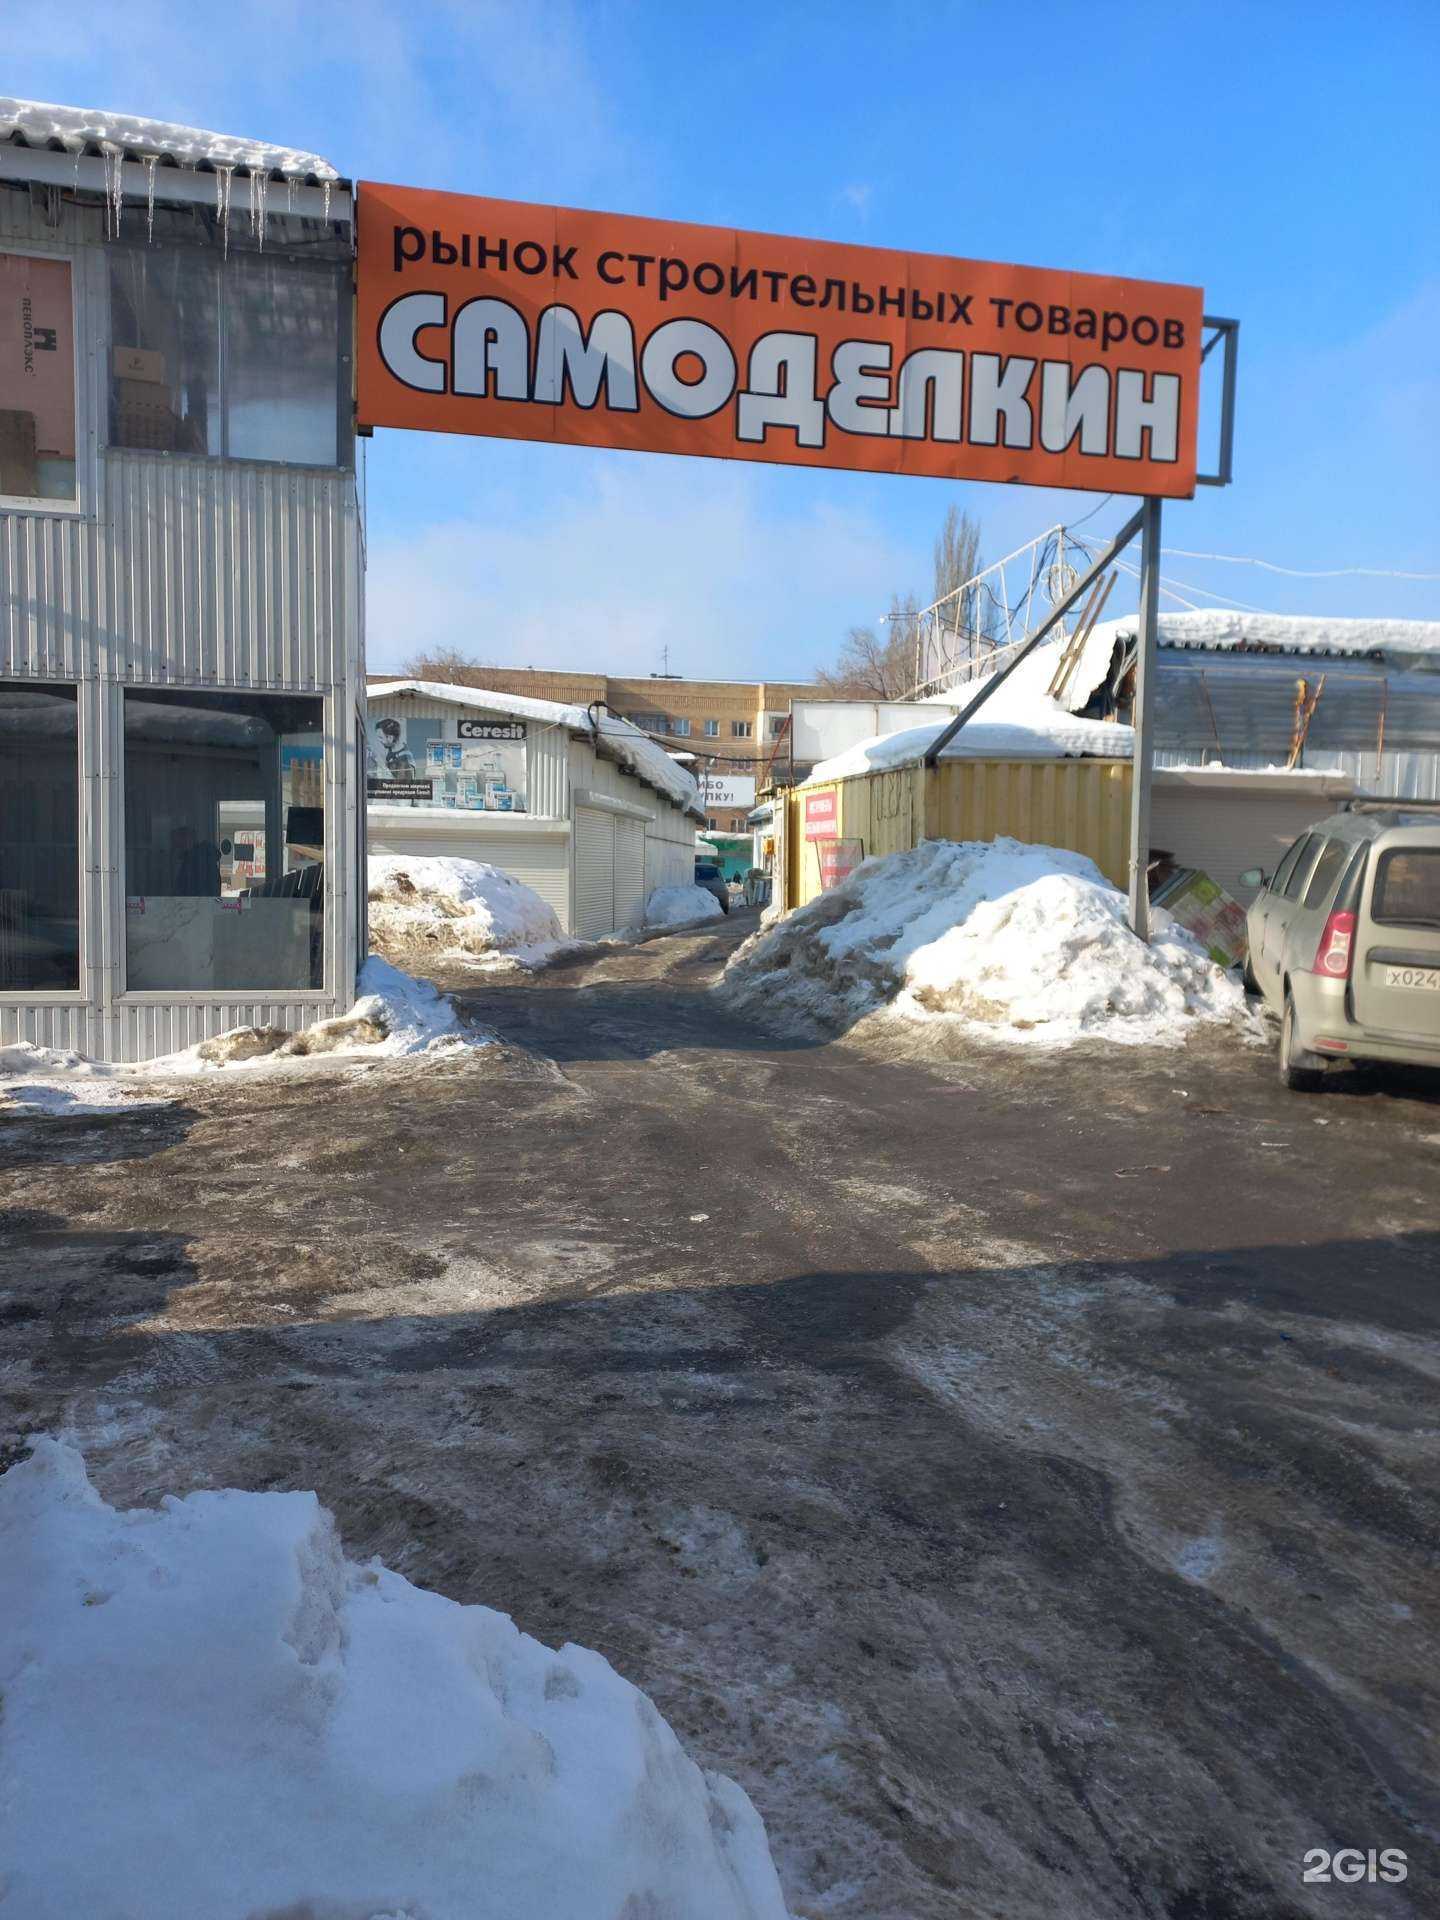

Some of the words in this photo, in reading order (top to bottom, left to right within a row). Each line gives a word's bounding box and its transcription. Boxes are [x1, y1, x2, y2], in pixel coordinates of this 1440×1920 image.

[393, 225, 579, 279] рынок
[597, 249, 975, 326] строительных
[989, 297, 1186, 352] товаров
[376, 290, 1182, 464] САМОДЕЛКИН
[460, 722, 524, 739] Ceresit
